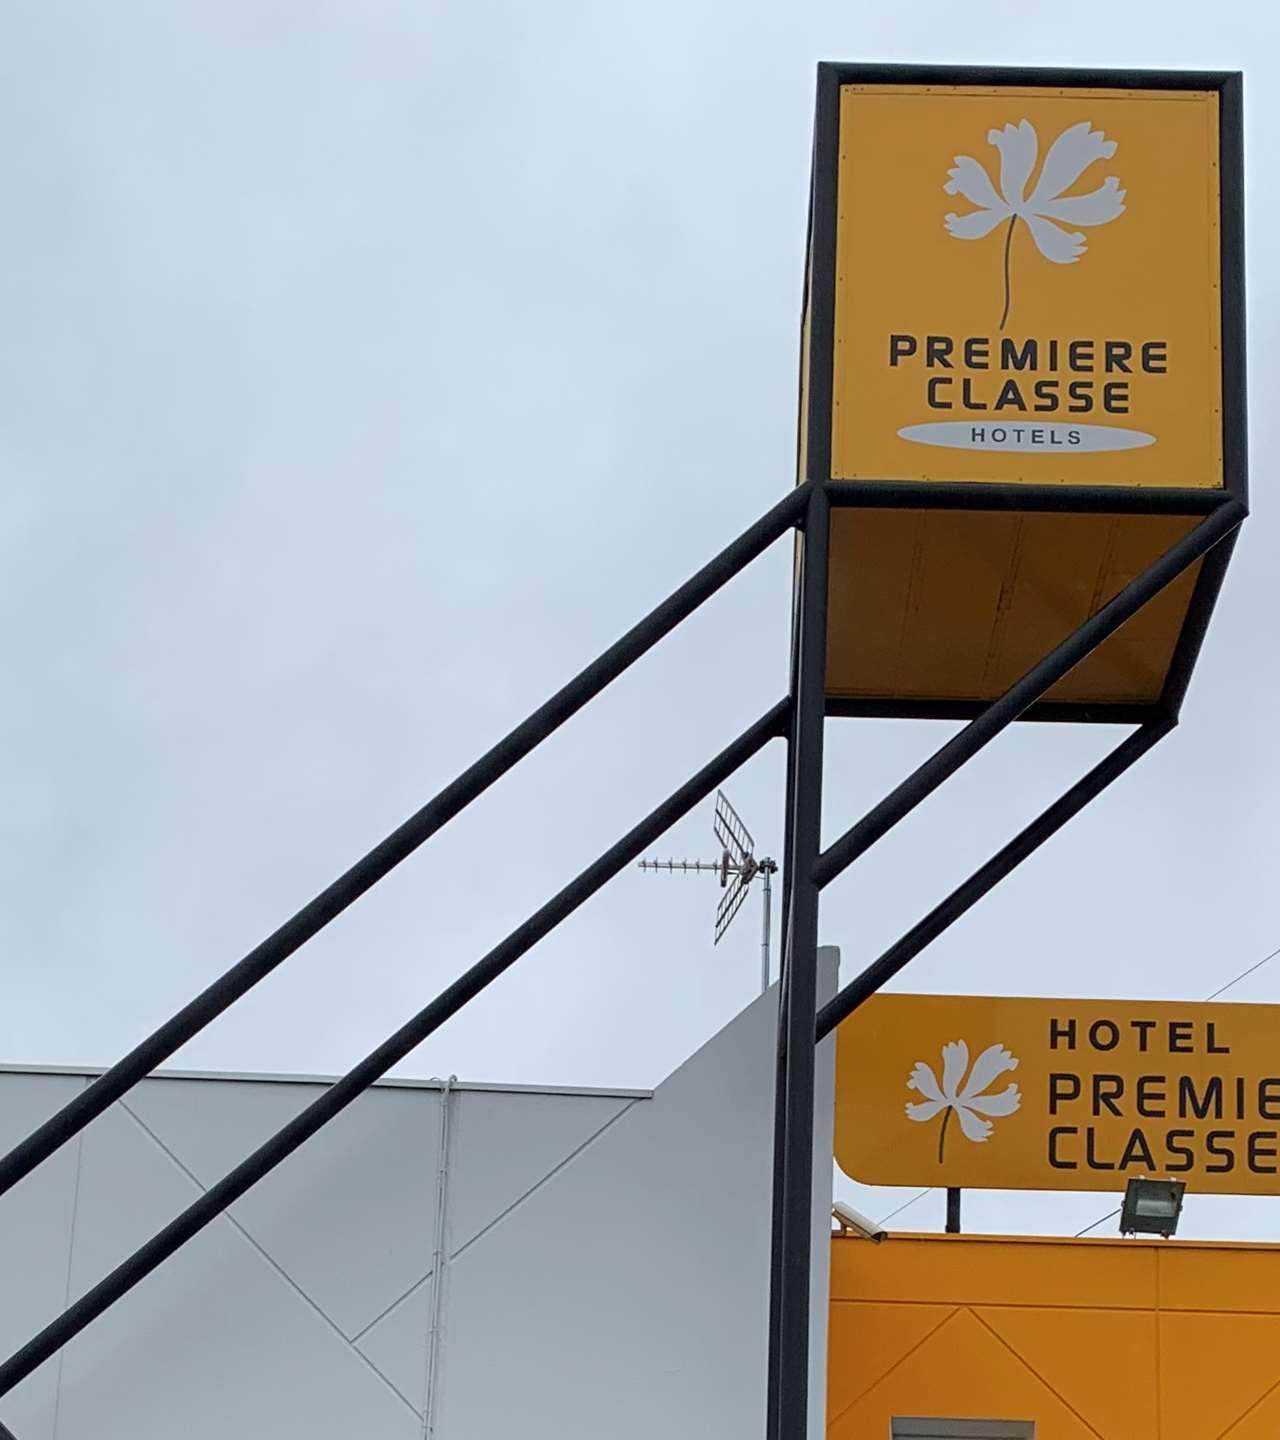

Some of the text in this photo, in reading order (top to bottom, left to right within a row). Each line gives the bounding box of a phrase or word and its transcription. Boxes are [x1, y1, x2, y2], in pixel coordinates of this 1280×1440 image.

[889, 334, 1168, 374] PREMIERE
[927, 376, 1130, 414] CLASSE
[970, 426, 1081, 446] HOTELS
[1049, 1018, 1231, 1055] HOTEL
[1047, 1126, 1279, 1175] CLASSE
